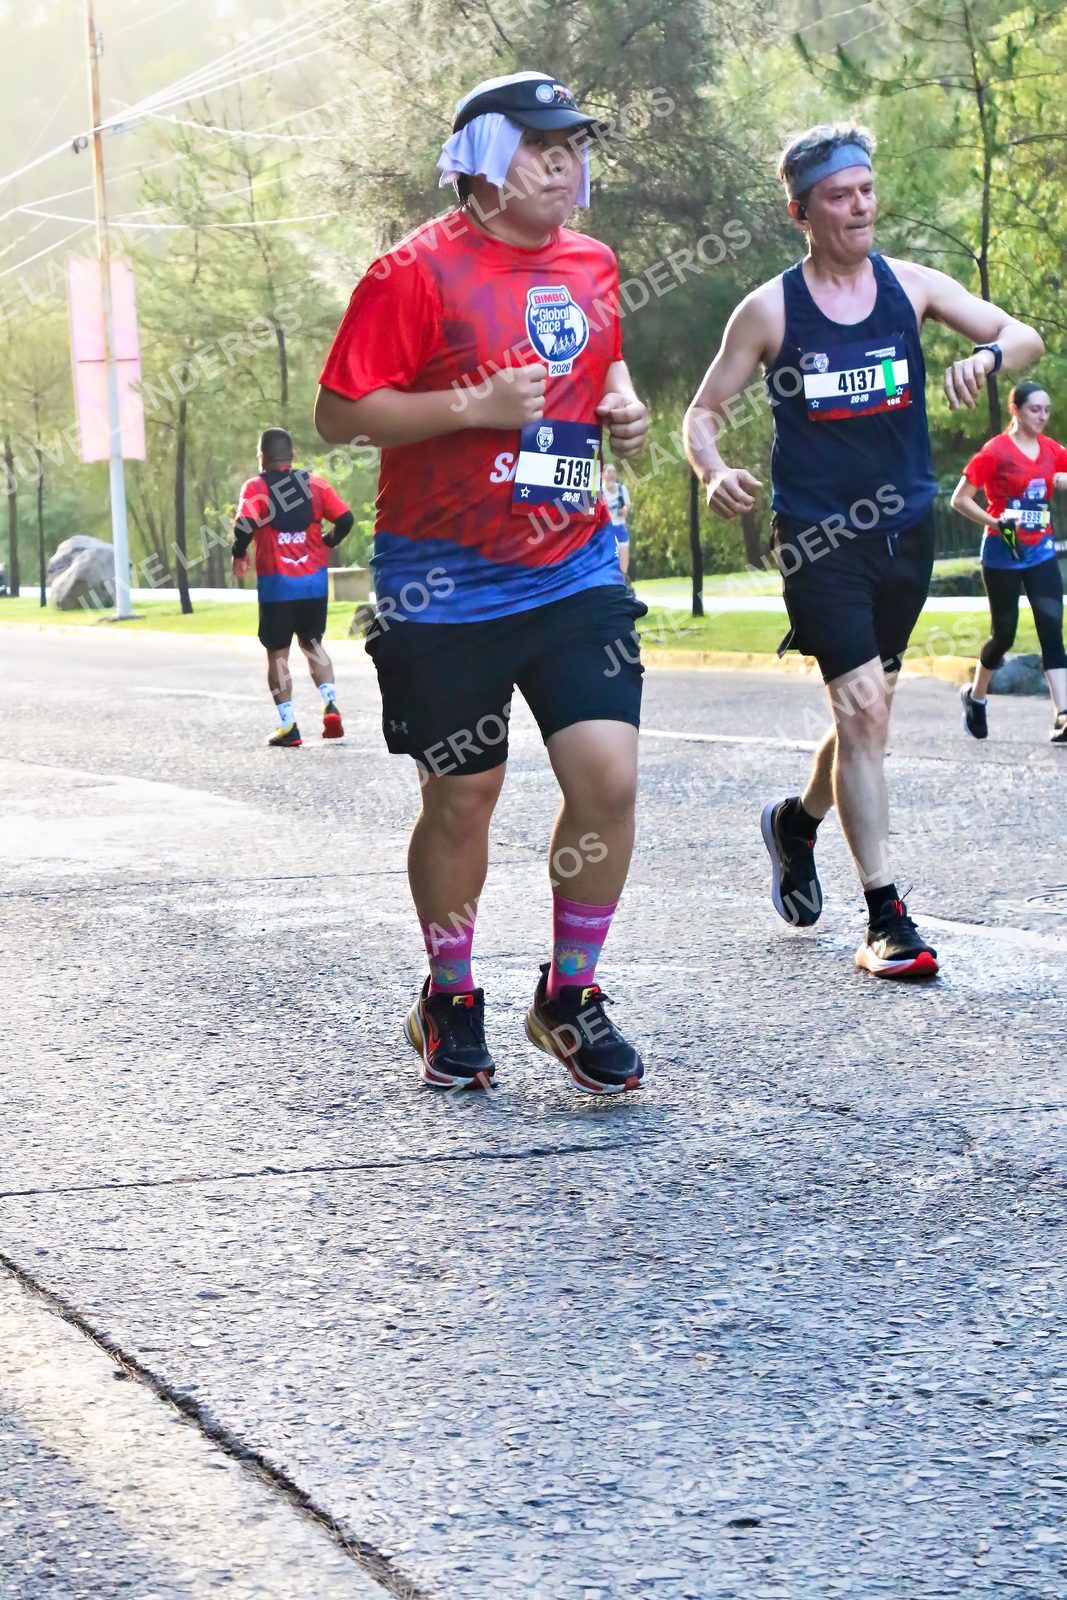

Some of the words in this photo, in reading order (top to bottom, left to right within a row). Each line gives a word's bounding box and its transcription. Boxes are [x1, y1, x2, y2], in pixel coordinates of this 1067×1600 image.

[533, 293, 566, 304] BIMBO
[540, 305, 570, 321] Global
[536, 320, 561, 334] Race
[551, 363, 571, 374] 2026
[838, 368, 876, 392] 4137
[554, 458, 591, 488] 5139
